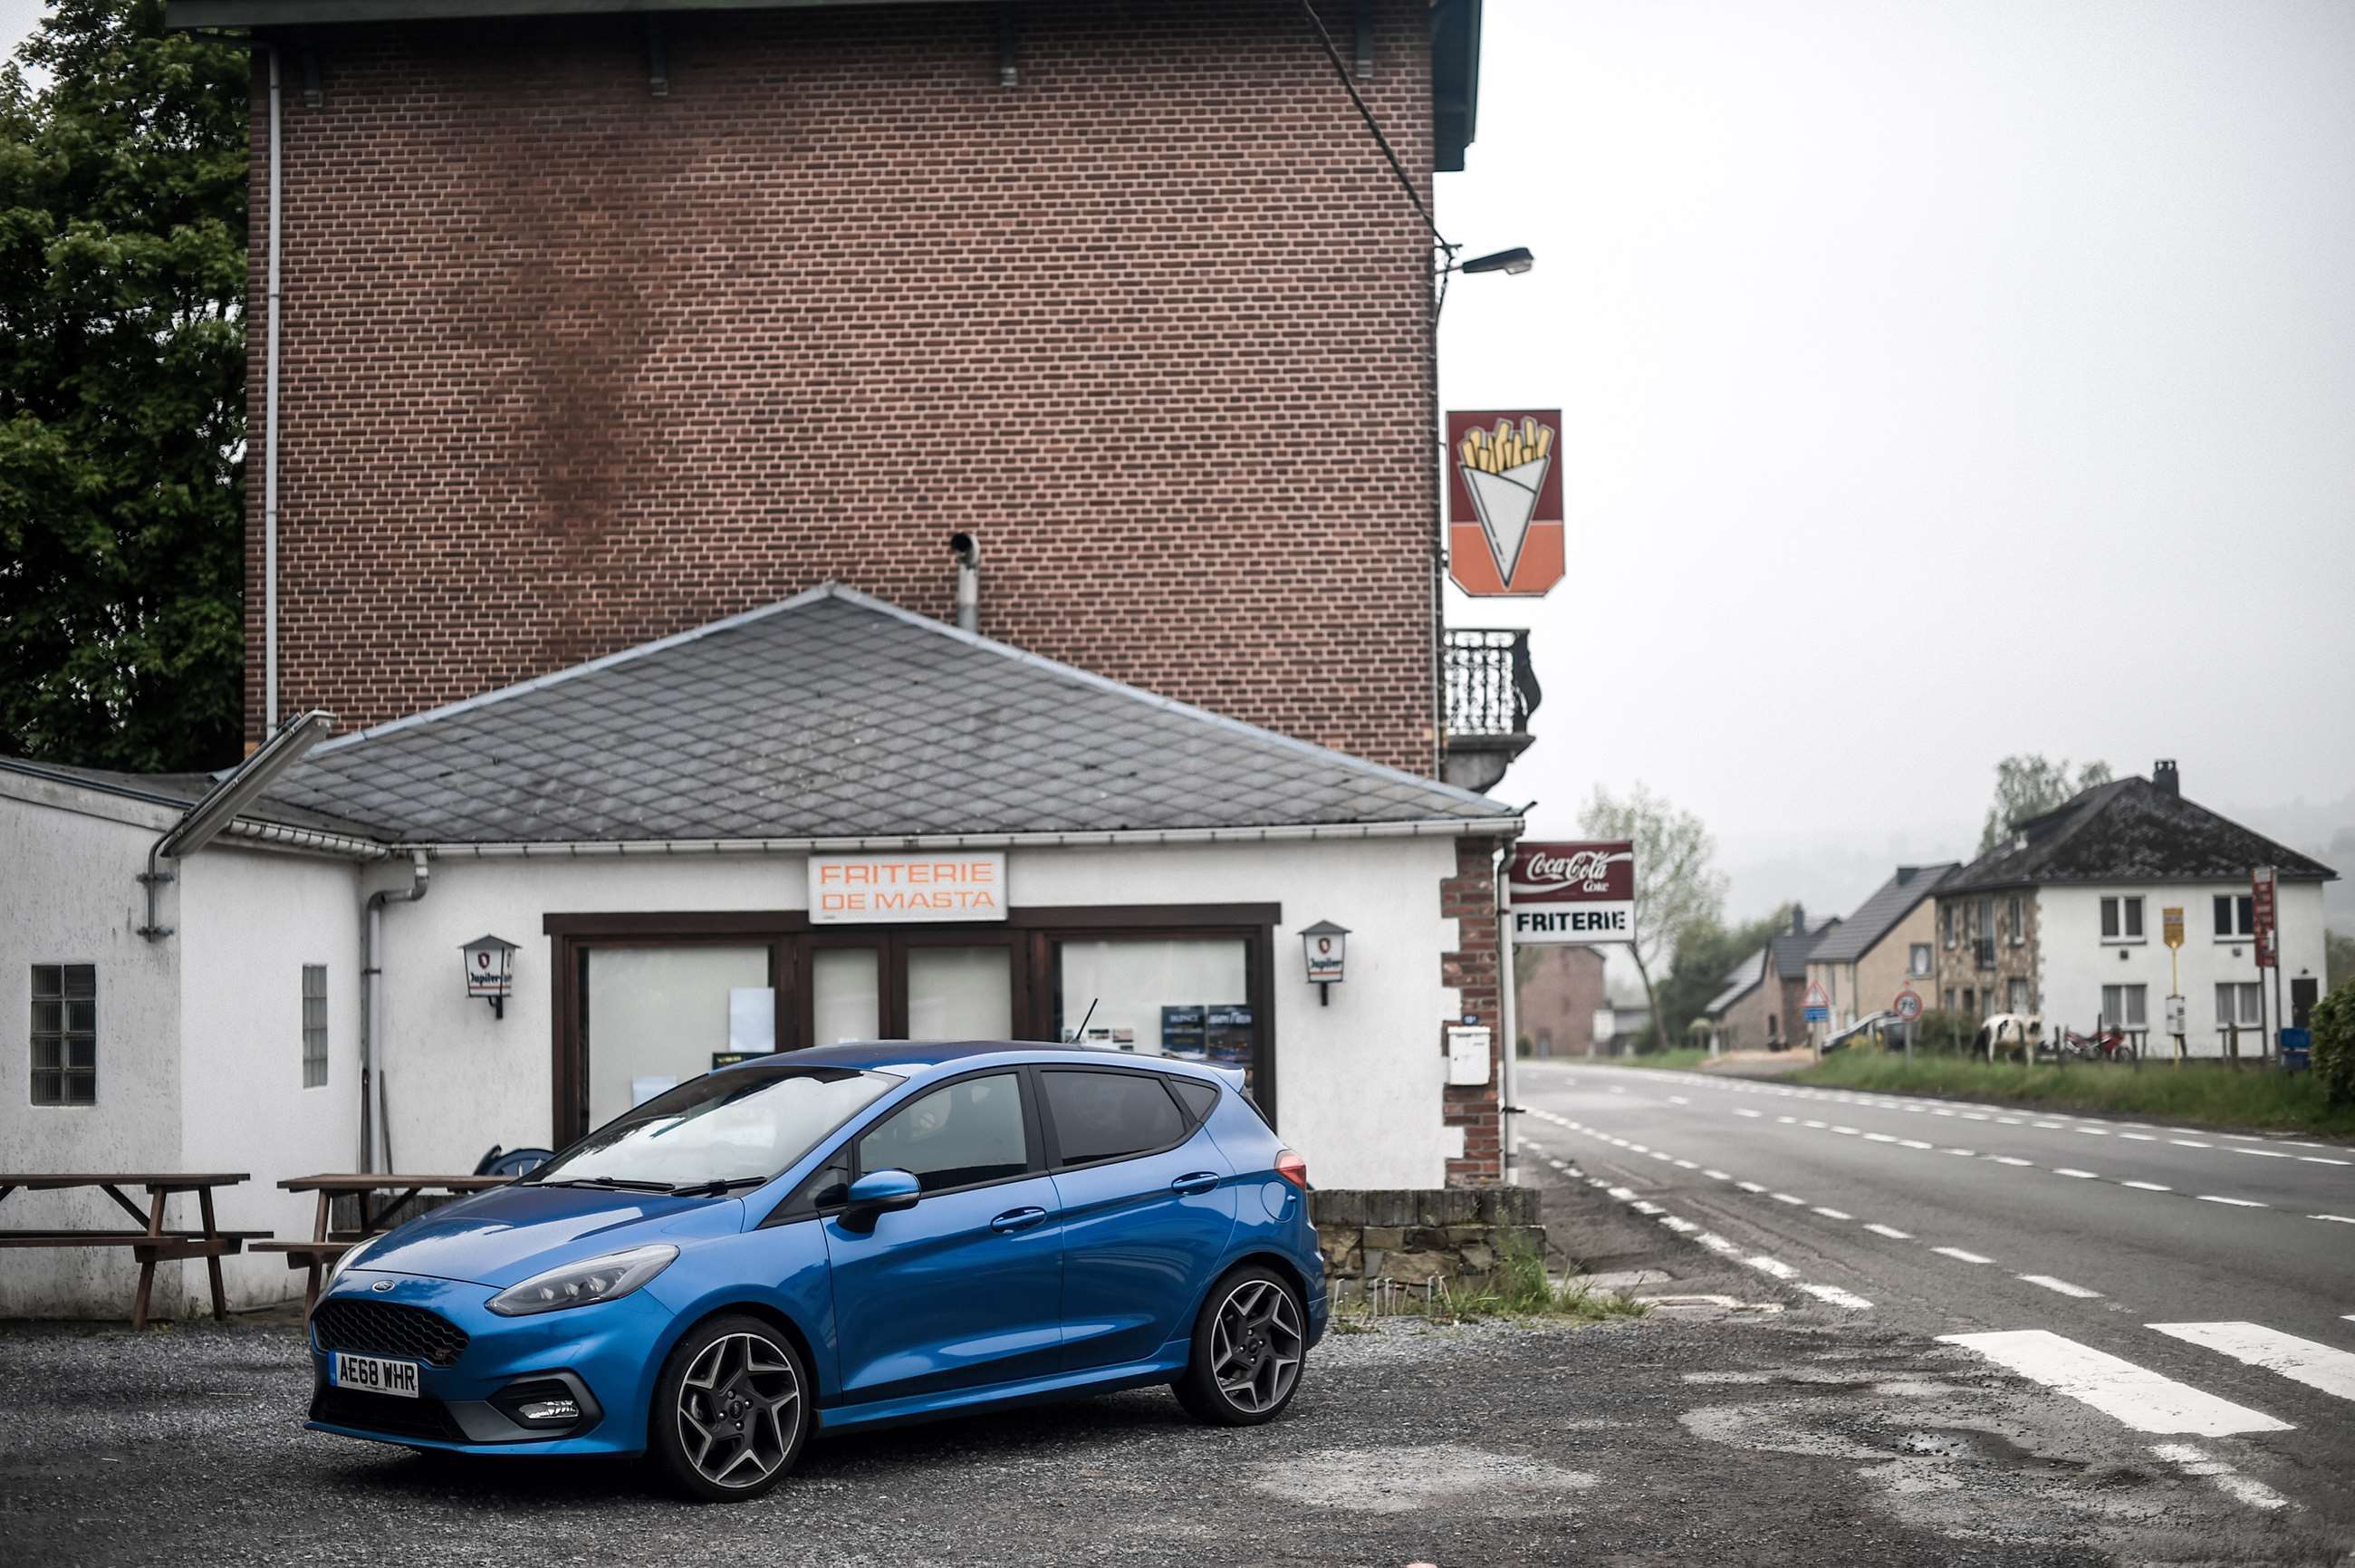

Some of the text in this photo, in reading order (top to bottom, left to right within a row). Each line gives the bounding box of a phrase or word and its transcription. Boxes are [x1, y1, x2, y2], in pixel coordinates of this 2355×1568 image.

[821, 861, 993, 884] FRITERIE
[1582, 880, 1610, 892] Coke
[822, 891, 995, 910] DE MASTA
[1516, 911, 1626, 932] FRITERIE
[341, 1355, 416, 1391] AE68 WHR
